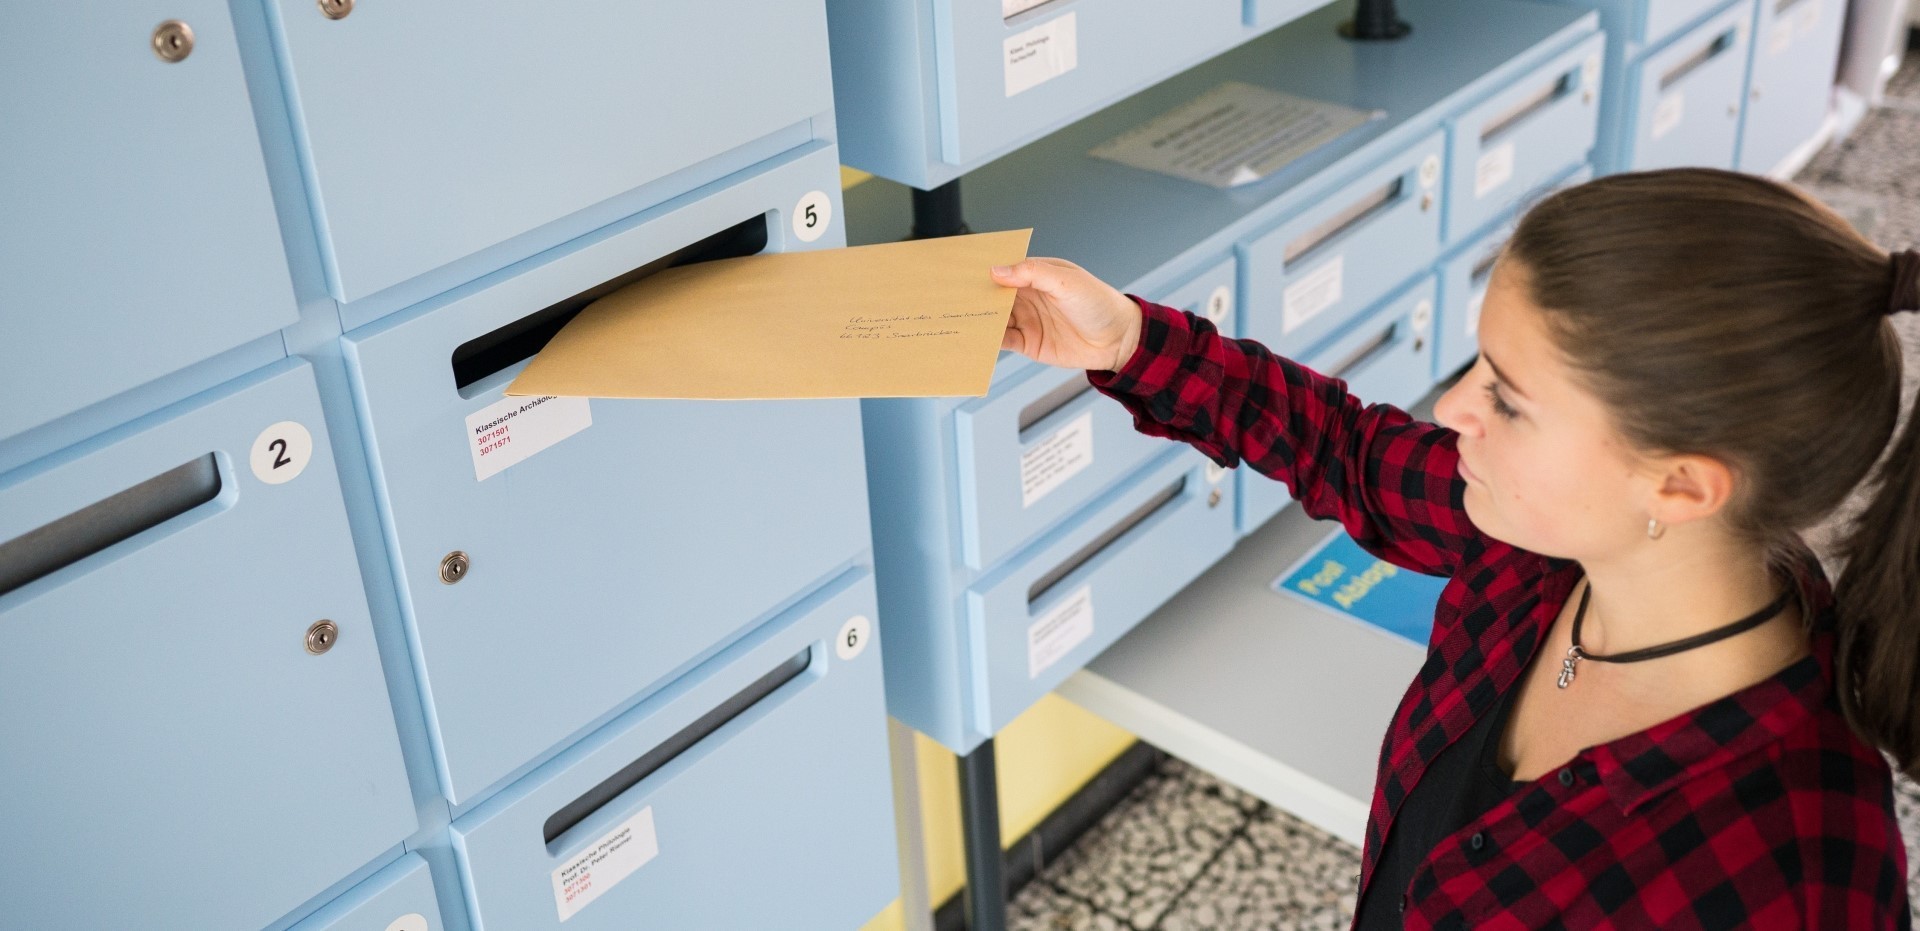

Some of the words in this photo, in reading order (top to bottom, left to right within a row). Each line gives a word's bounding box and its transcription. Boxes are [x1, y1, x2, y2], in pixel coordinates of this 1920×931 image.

[805, 203, 818, 229] 5
[475, 410, 518, 435] Klassische
[477, 425, 509, 445] 3071501
[268, 438, 292, 470] 2
[479, 435, 511, 456] 3071571
[1298, 560, 1346, 595] Post
[847, 628, 857, 648] 6
[561, 850, 597, 877] Klassische
[598, 828, 630, 851] Philologie
[562, 872, 578, 886] Prof.
[579, 865, 591, 874] Dr.
[591, 852, 608, 866] Peter
